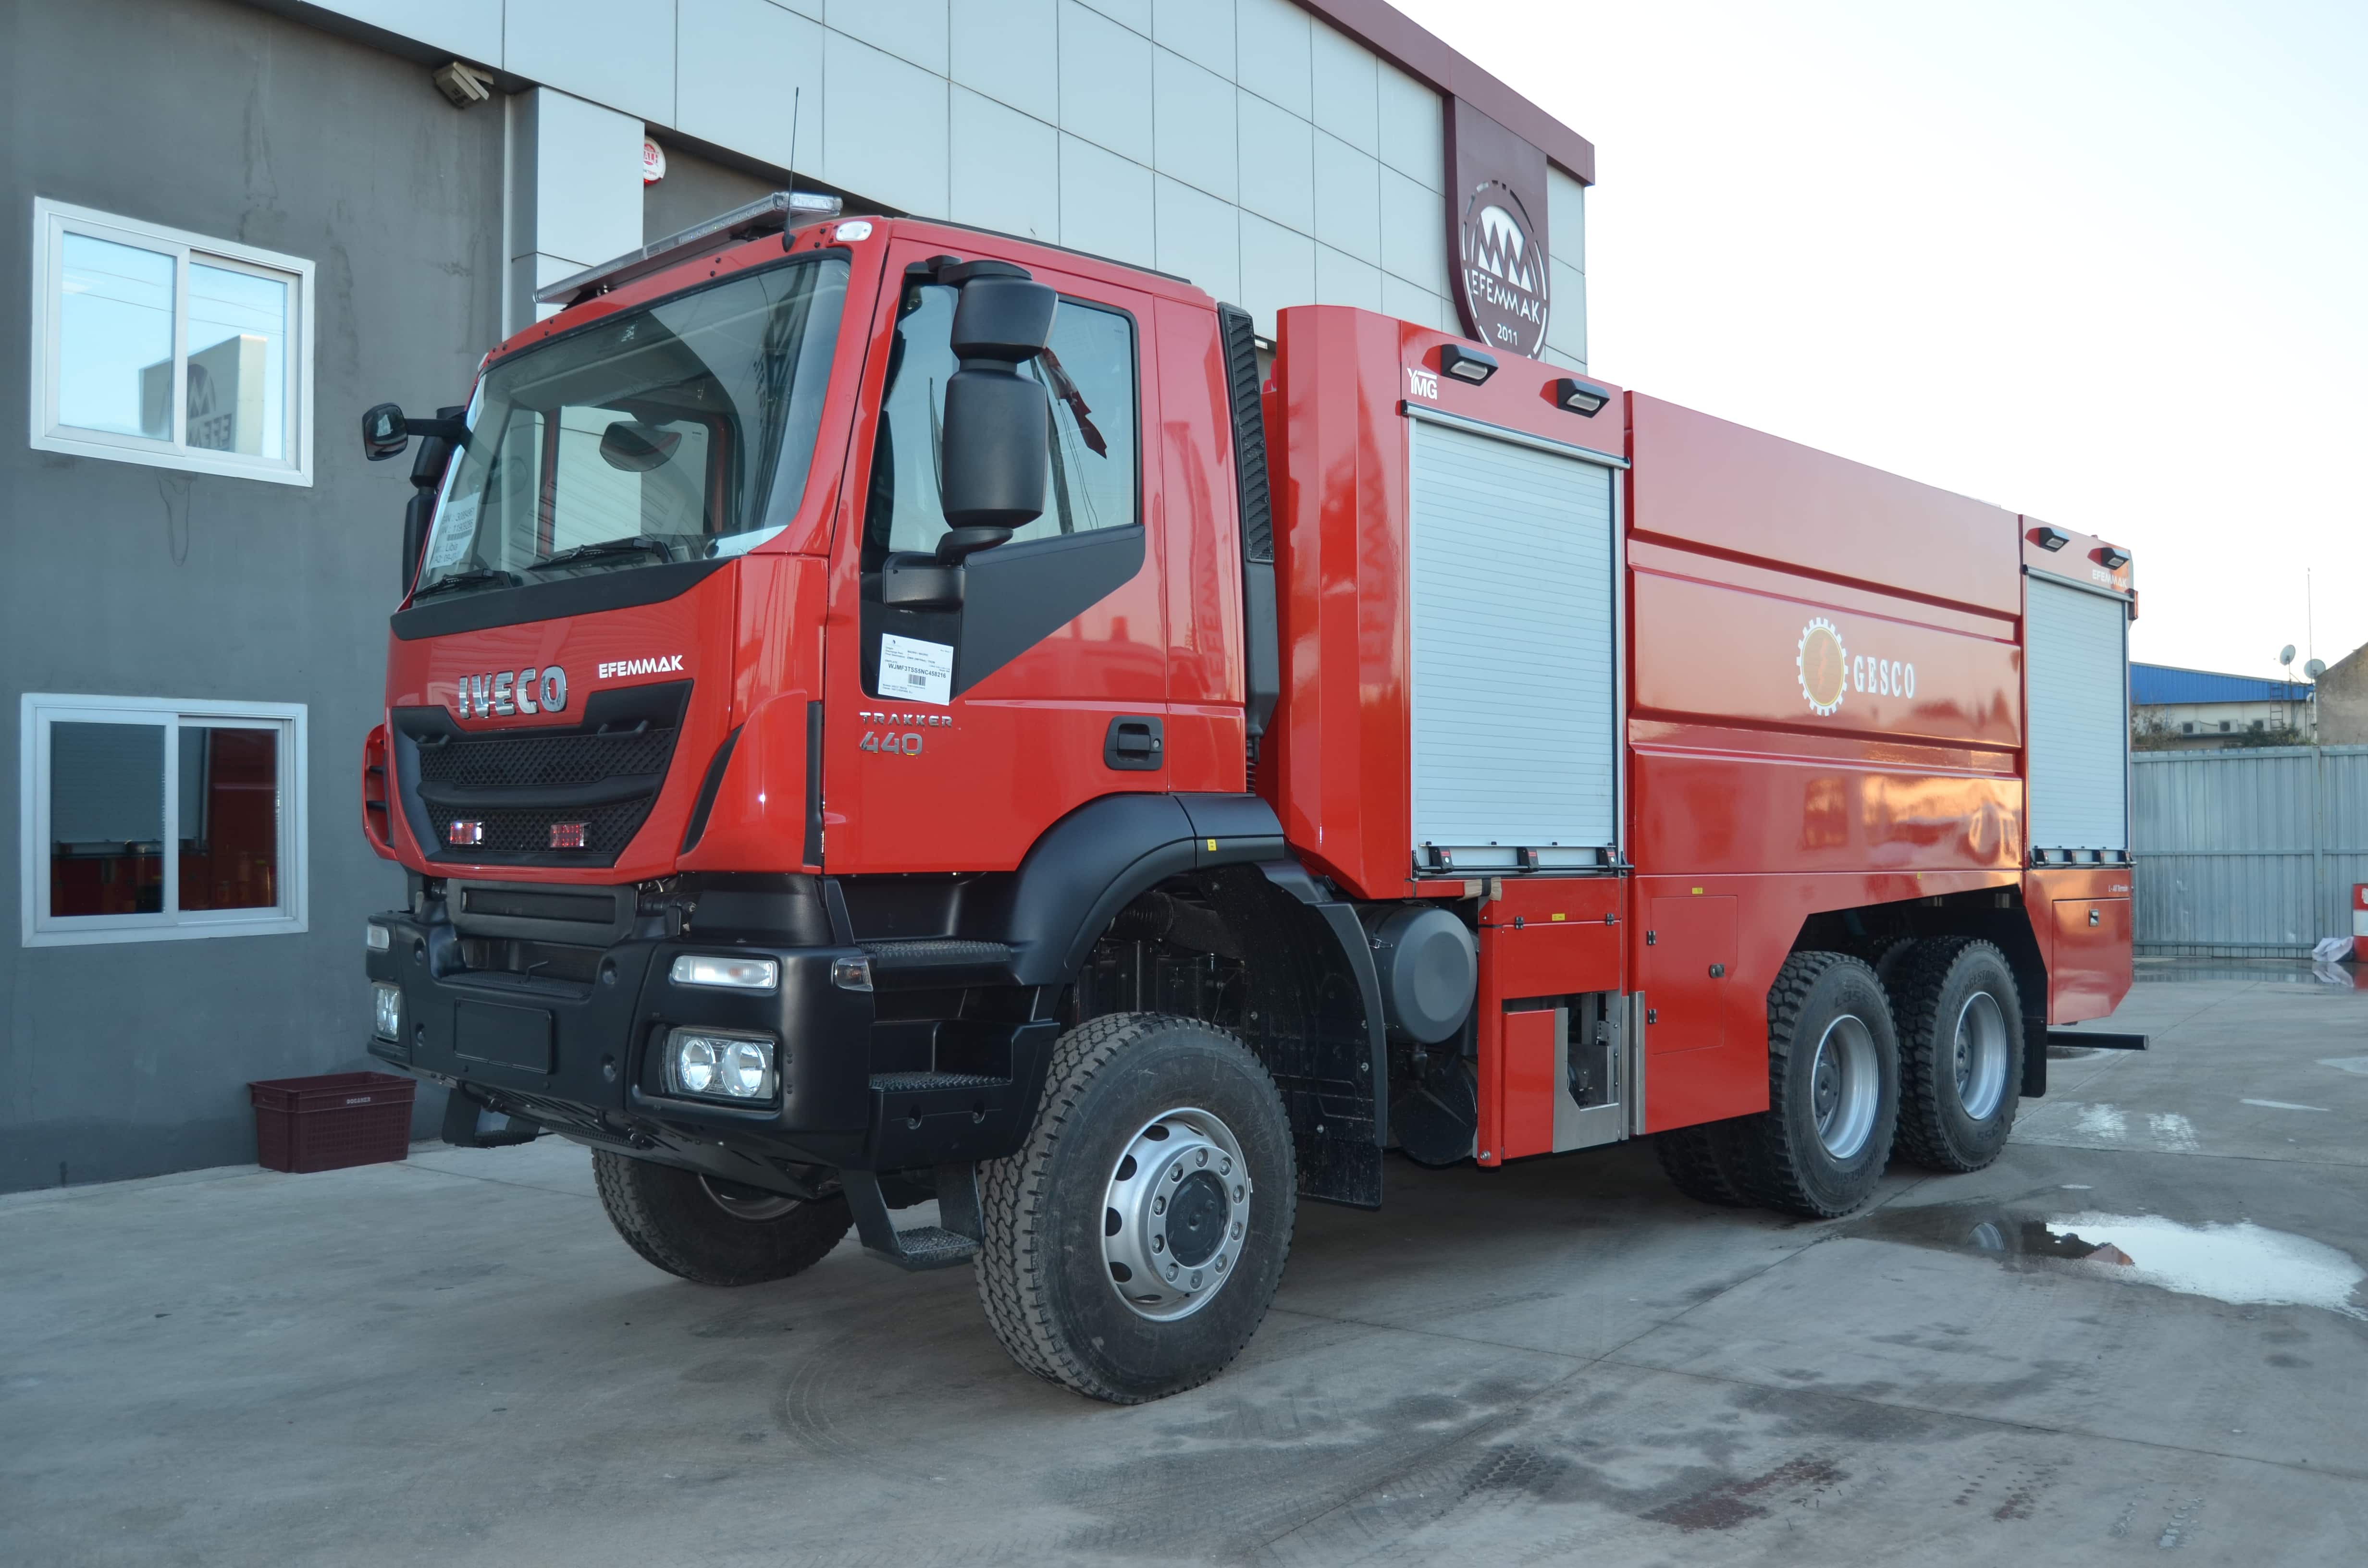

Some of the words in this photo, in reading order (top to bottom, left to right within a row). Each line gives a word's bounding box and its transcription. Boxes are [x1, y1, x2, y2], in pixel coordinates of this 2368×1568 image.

[1472, 270, 1540, 325] EFEMMAK
[1497, 323, 1518, 345] 2011
[2092, 569, 2127, 588] EFEMMAK
[599, 655, 684, 678] EFEMMAK
[888, 663, 946, 678] WJMF3TSS5NC458216
[1853, 655, 1914, 699] GESCO
[458, 665, 567, 720] IVECO
[859, 712, 952, 727] TRAKKER
[859, 731, 923, 756] 440
